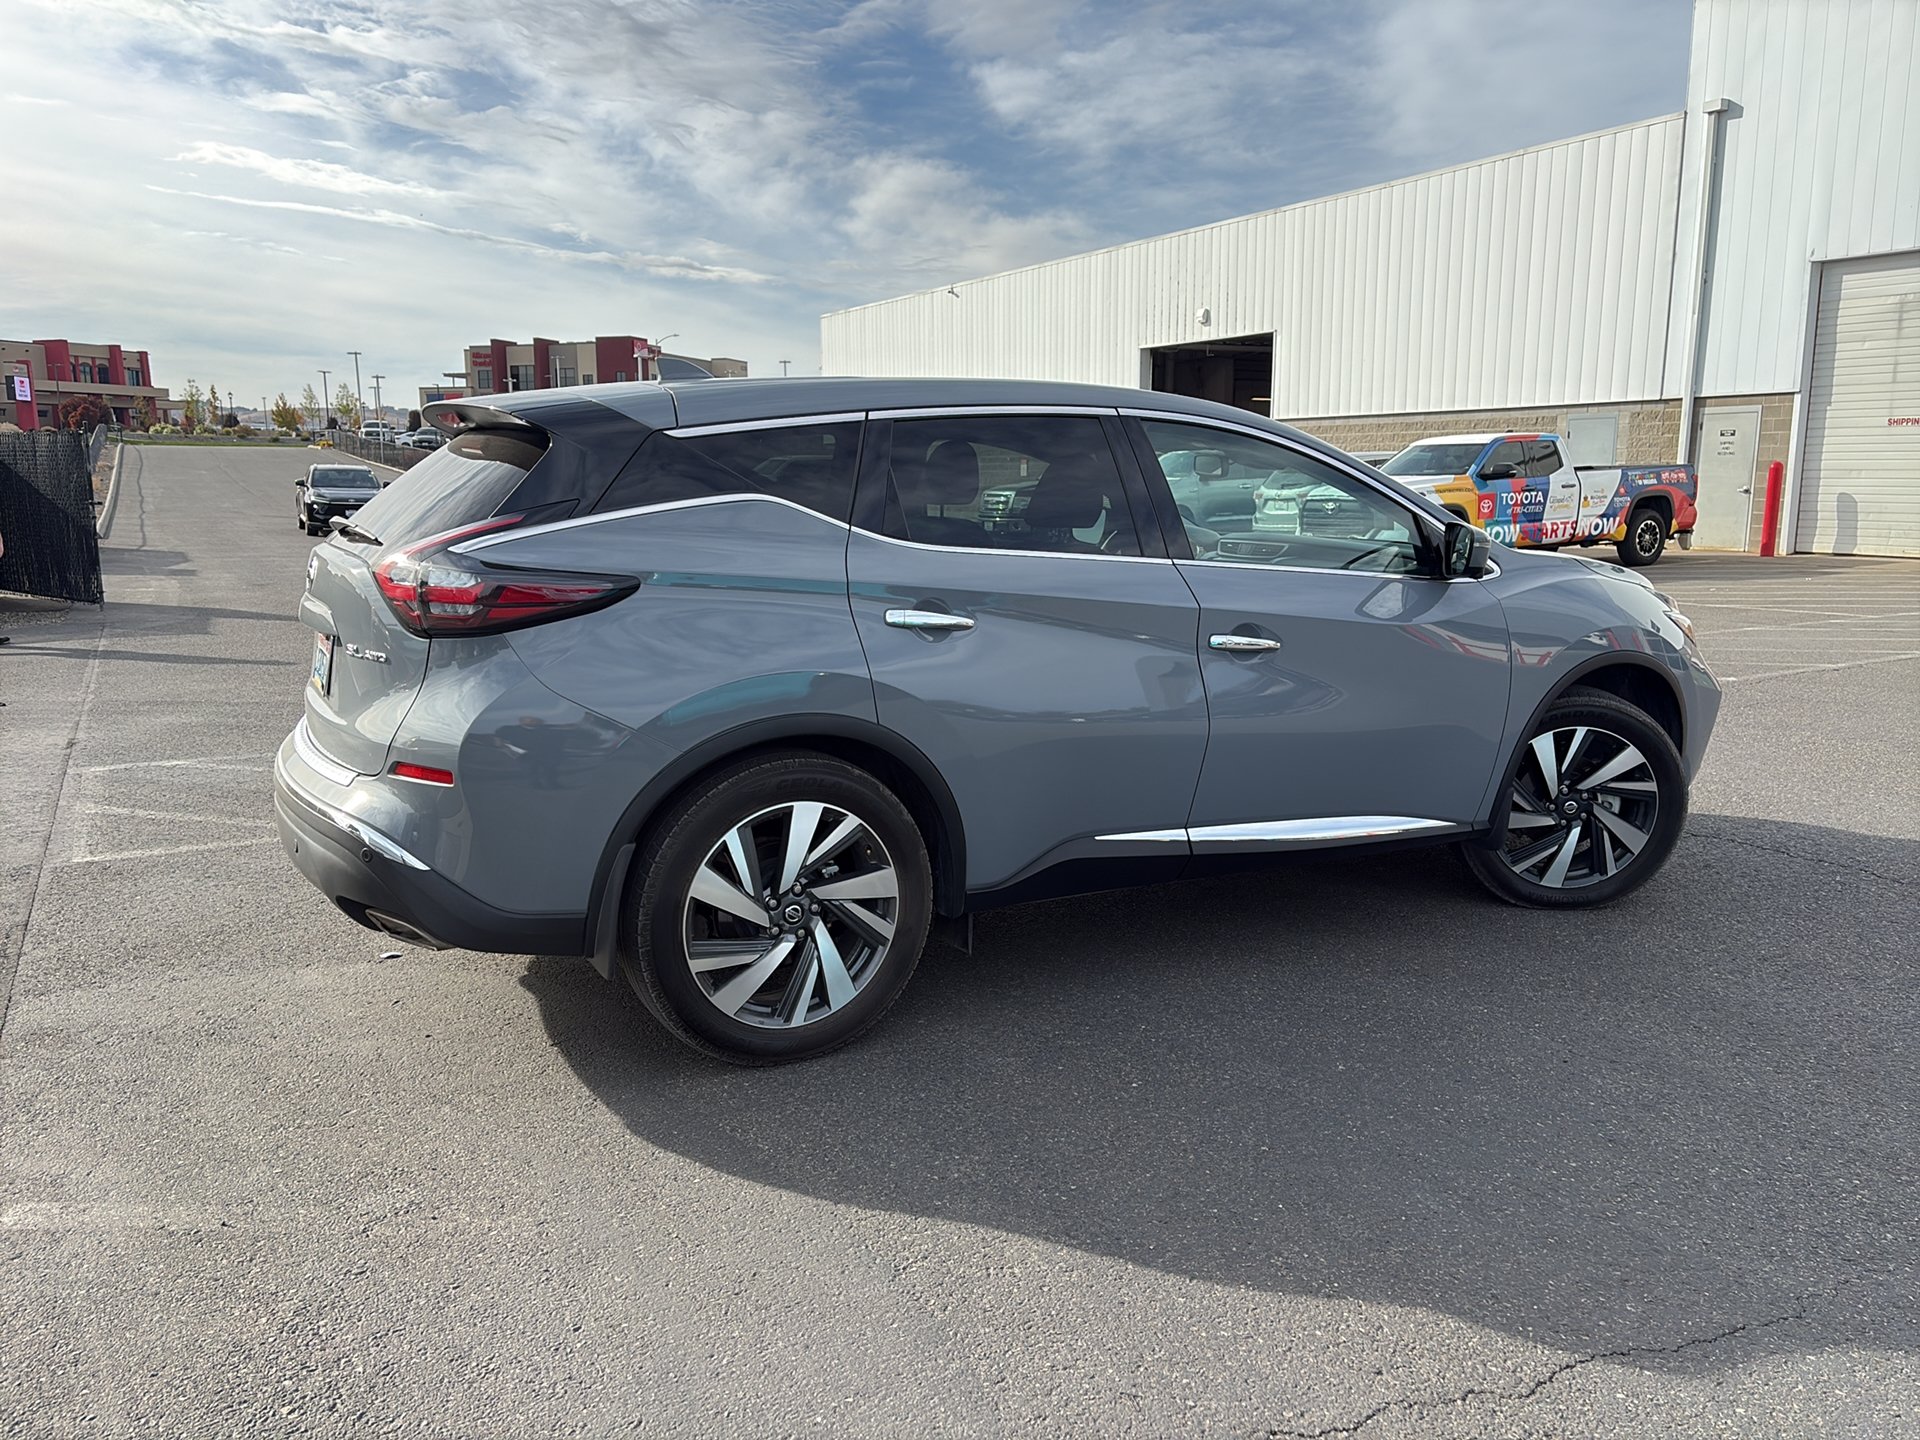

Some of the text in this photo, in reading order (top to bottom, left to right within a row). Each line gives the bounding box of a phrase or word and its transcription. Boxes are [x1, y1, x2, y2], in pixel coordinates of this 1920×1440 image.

[1500, 491, 1544, 505] TOYOTA
[1520, 520, 1577, 541] STARTS
[1577, 516, 1620, 536] NOW
